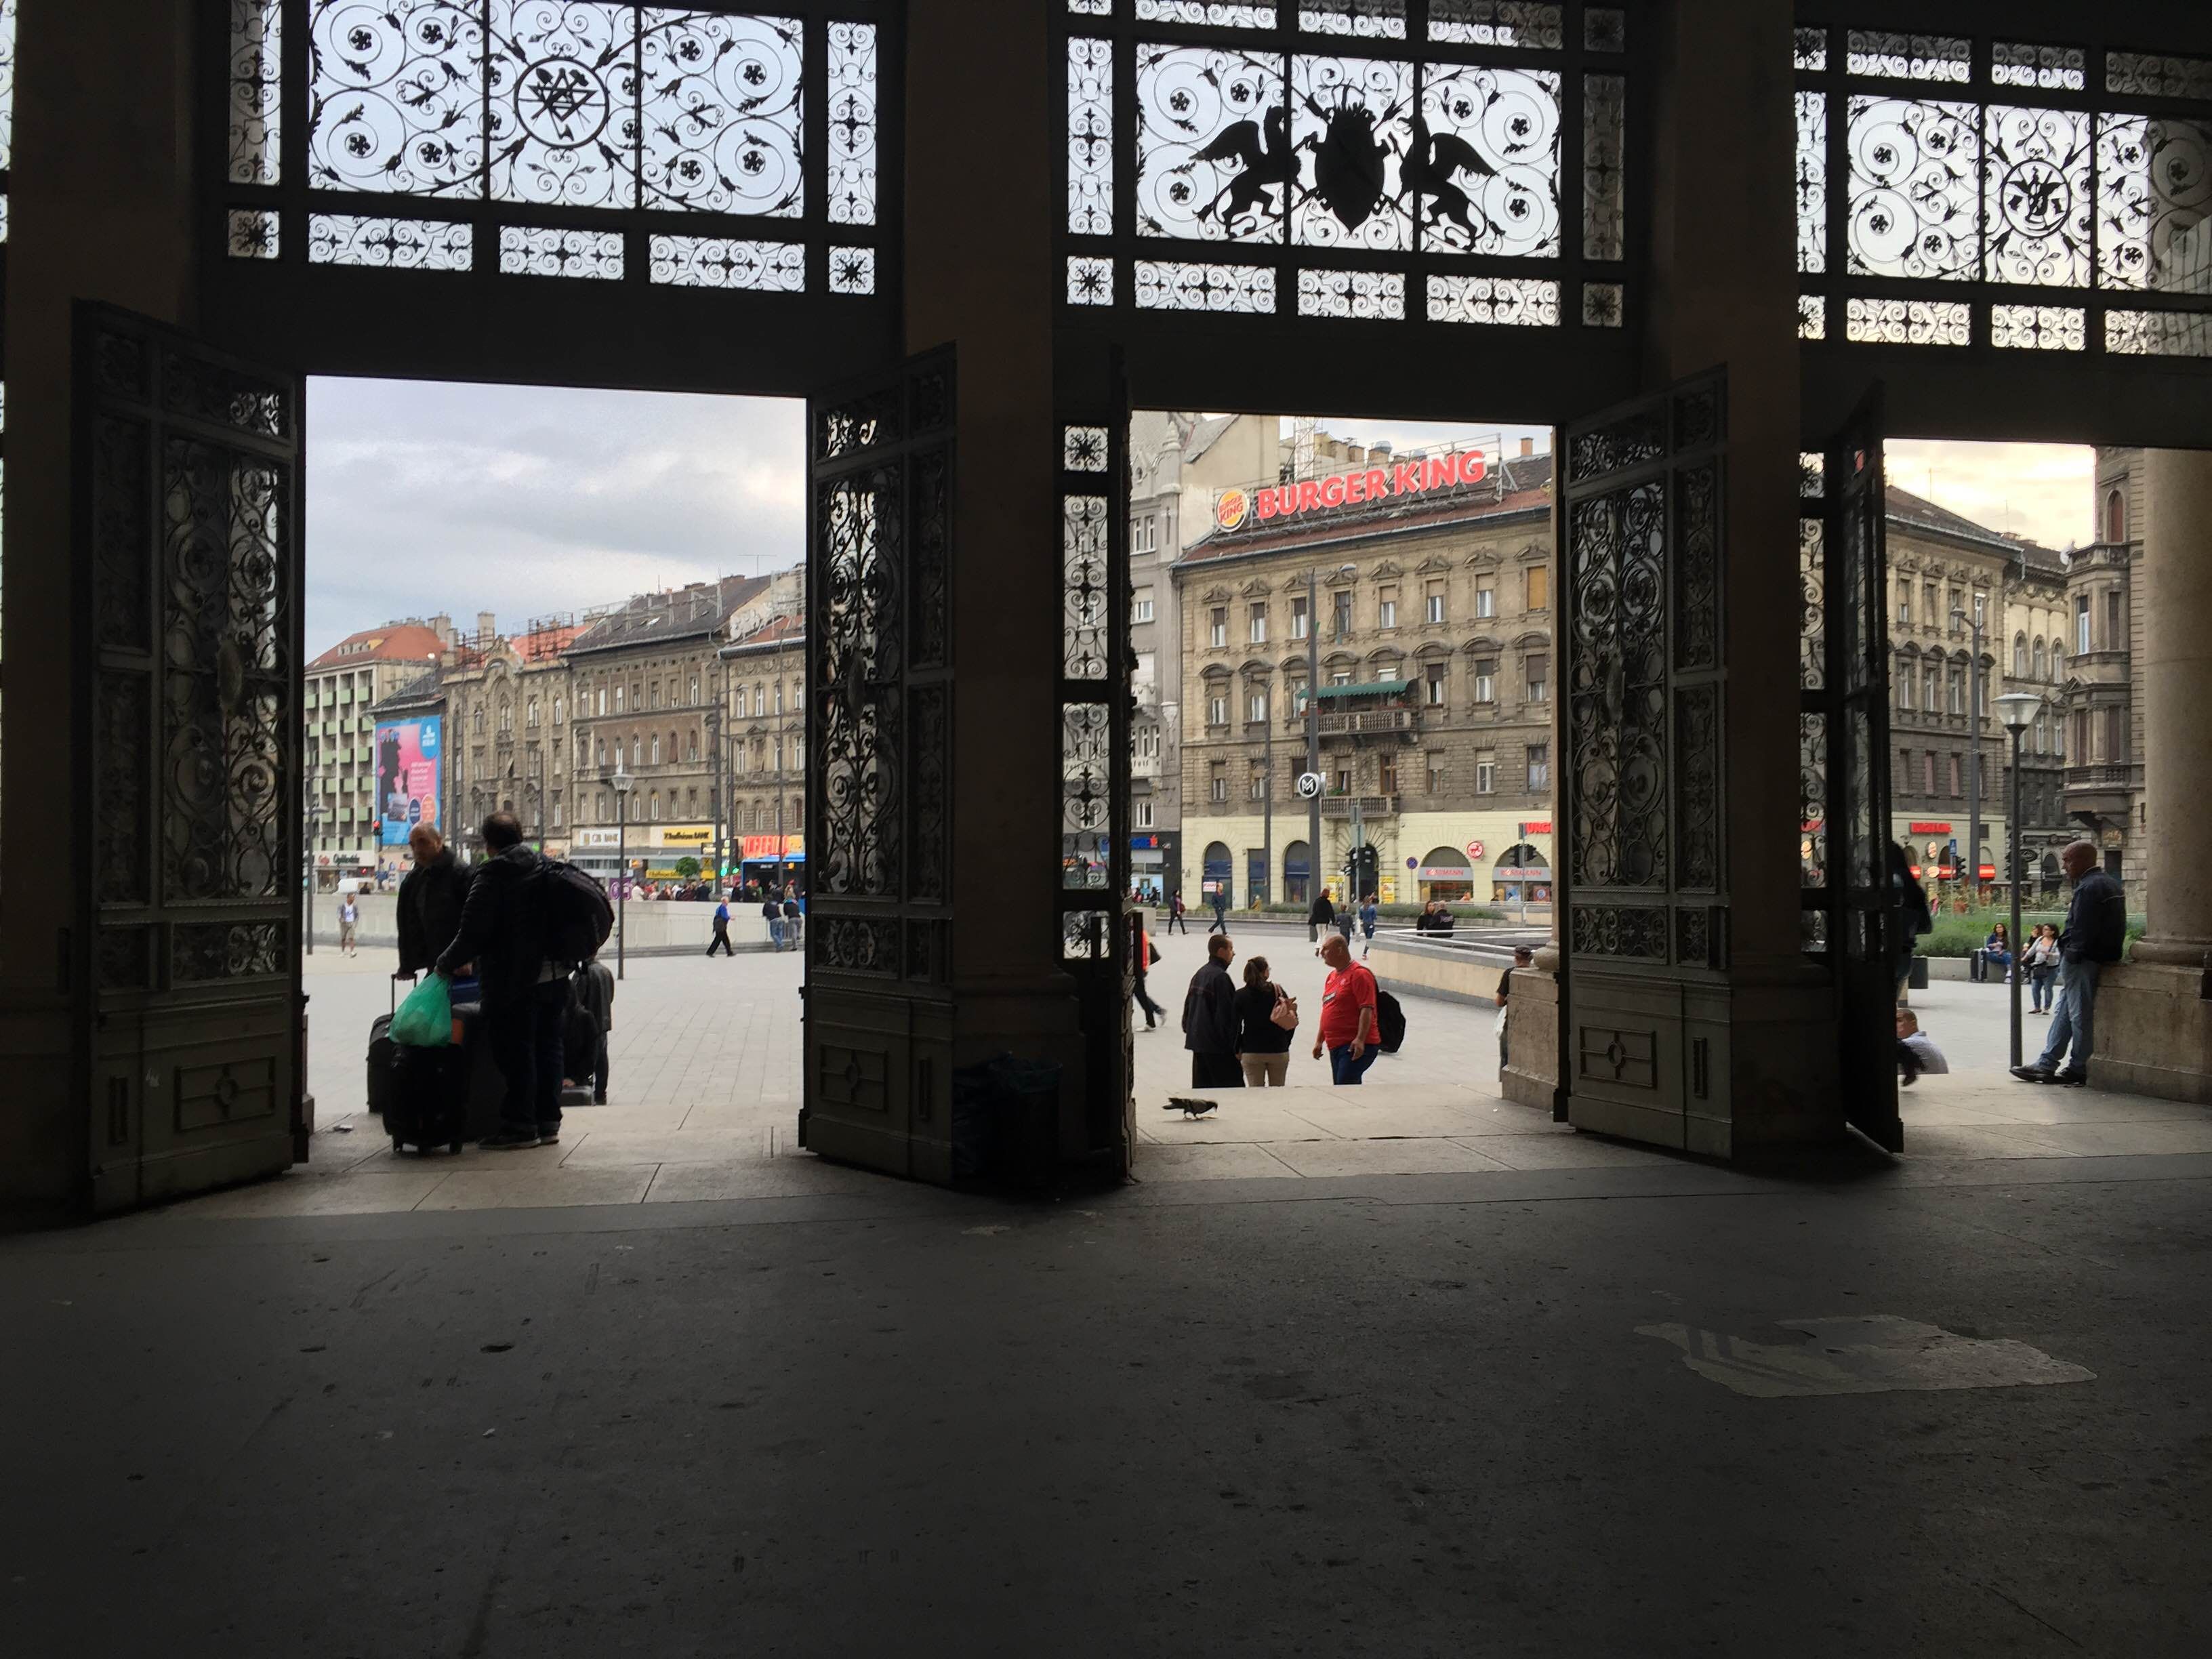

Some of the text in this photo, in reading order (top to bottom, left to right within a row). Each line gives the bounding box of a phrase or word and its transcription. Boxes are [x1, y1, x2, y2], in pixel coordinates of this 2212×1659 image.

[1257, 449, 1487, 520] BURGER KING
[1220, 501, 1244, 522] KING
[1526, 822, 1551, 834] URG
